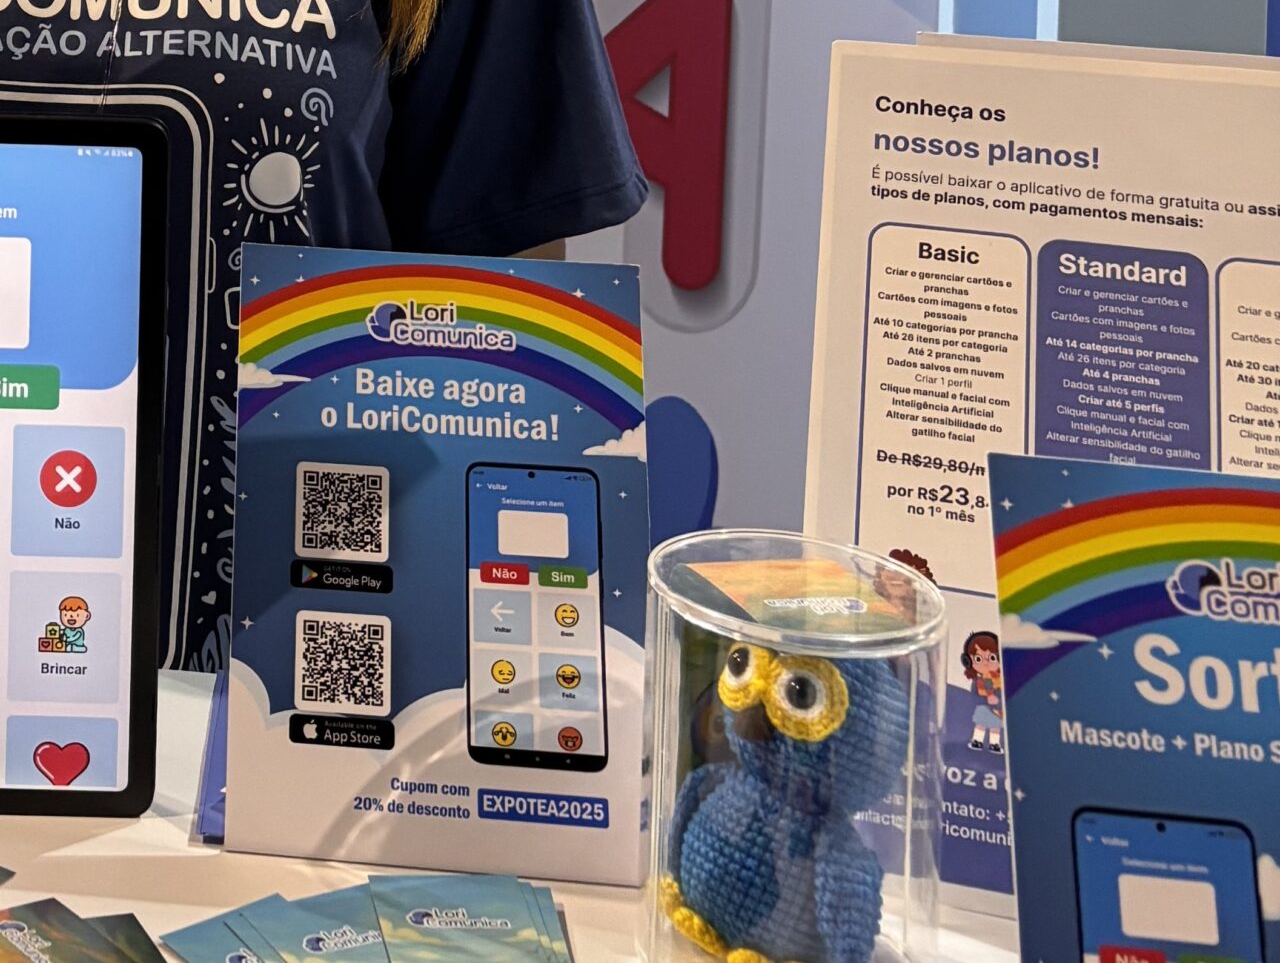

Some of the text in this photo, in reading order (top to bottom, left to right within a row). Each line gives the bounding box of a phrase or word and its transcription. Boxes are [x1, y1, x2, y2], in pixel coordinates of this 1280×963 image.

[96, 28, 339, 80] ALTERNATIVA
[875, 95, 1006, 123] Conheça os
[874, 133, 1099, 170] nossos planos!
[871, 164, 1280, 218] É possível baixar o aplicativo de forma gratuita ou assi
[870, 185, 1204, 229] tipos de planos, com pagamentos mensais:
[918, 241, 980, 265] Basic
[1058, 253, 1187, 287] Standard
[410, 300, 456, 324] Lori
[393, 322, 514, 349] Comunica
[873, 316, 1019, 342] Até 10 categorias por prancha
[1045, 336, 1199, 364] Até 14 categorias por prancha
[886, 356, 1005, 380] Dados salvos em nuvem
[355, 367, 526, 407] Baixe agora
[320, 401, 559, 441] o LoriComunica!
[892, 397, 994, 419] Inteligência Artificial
[887, 484, 989, 510] por R$23,8
[54, 517, 81, 530] Não
[907, 504, 975, 523] no 1º mês
[322, 572, 382, 590] Google Play
[492, 567, 518, 580] Não
[551, 571, 575, 583] Sim
[1225, 561, 1280, 593] Lor
[1206, 590, 1280, 621] Com
[40, 662, 88, 676] Brincar
[323, 728, 381, 745] App Store
[1060, 719, 1166, 753] Mascote
[1171, 735, 1188, 751] +
[1194, 733, 1265, 762] Plano
[389, 775, 470, 797] Cupom com
[353, 795, 471, 819] 20% de desconto
[482, 794, 607, 821] EXPOTEA2025
